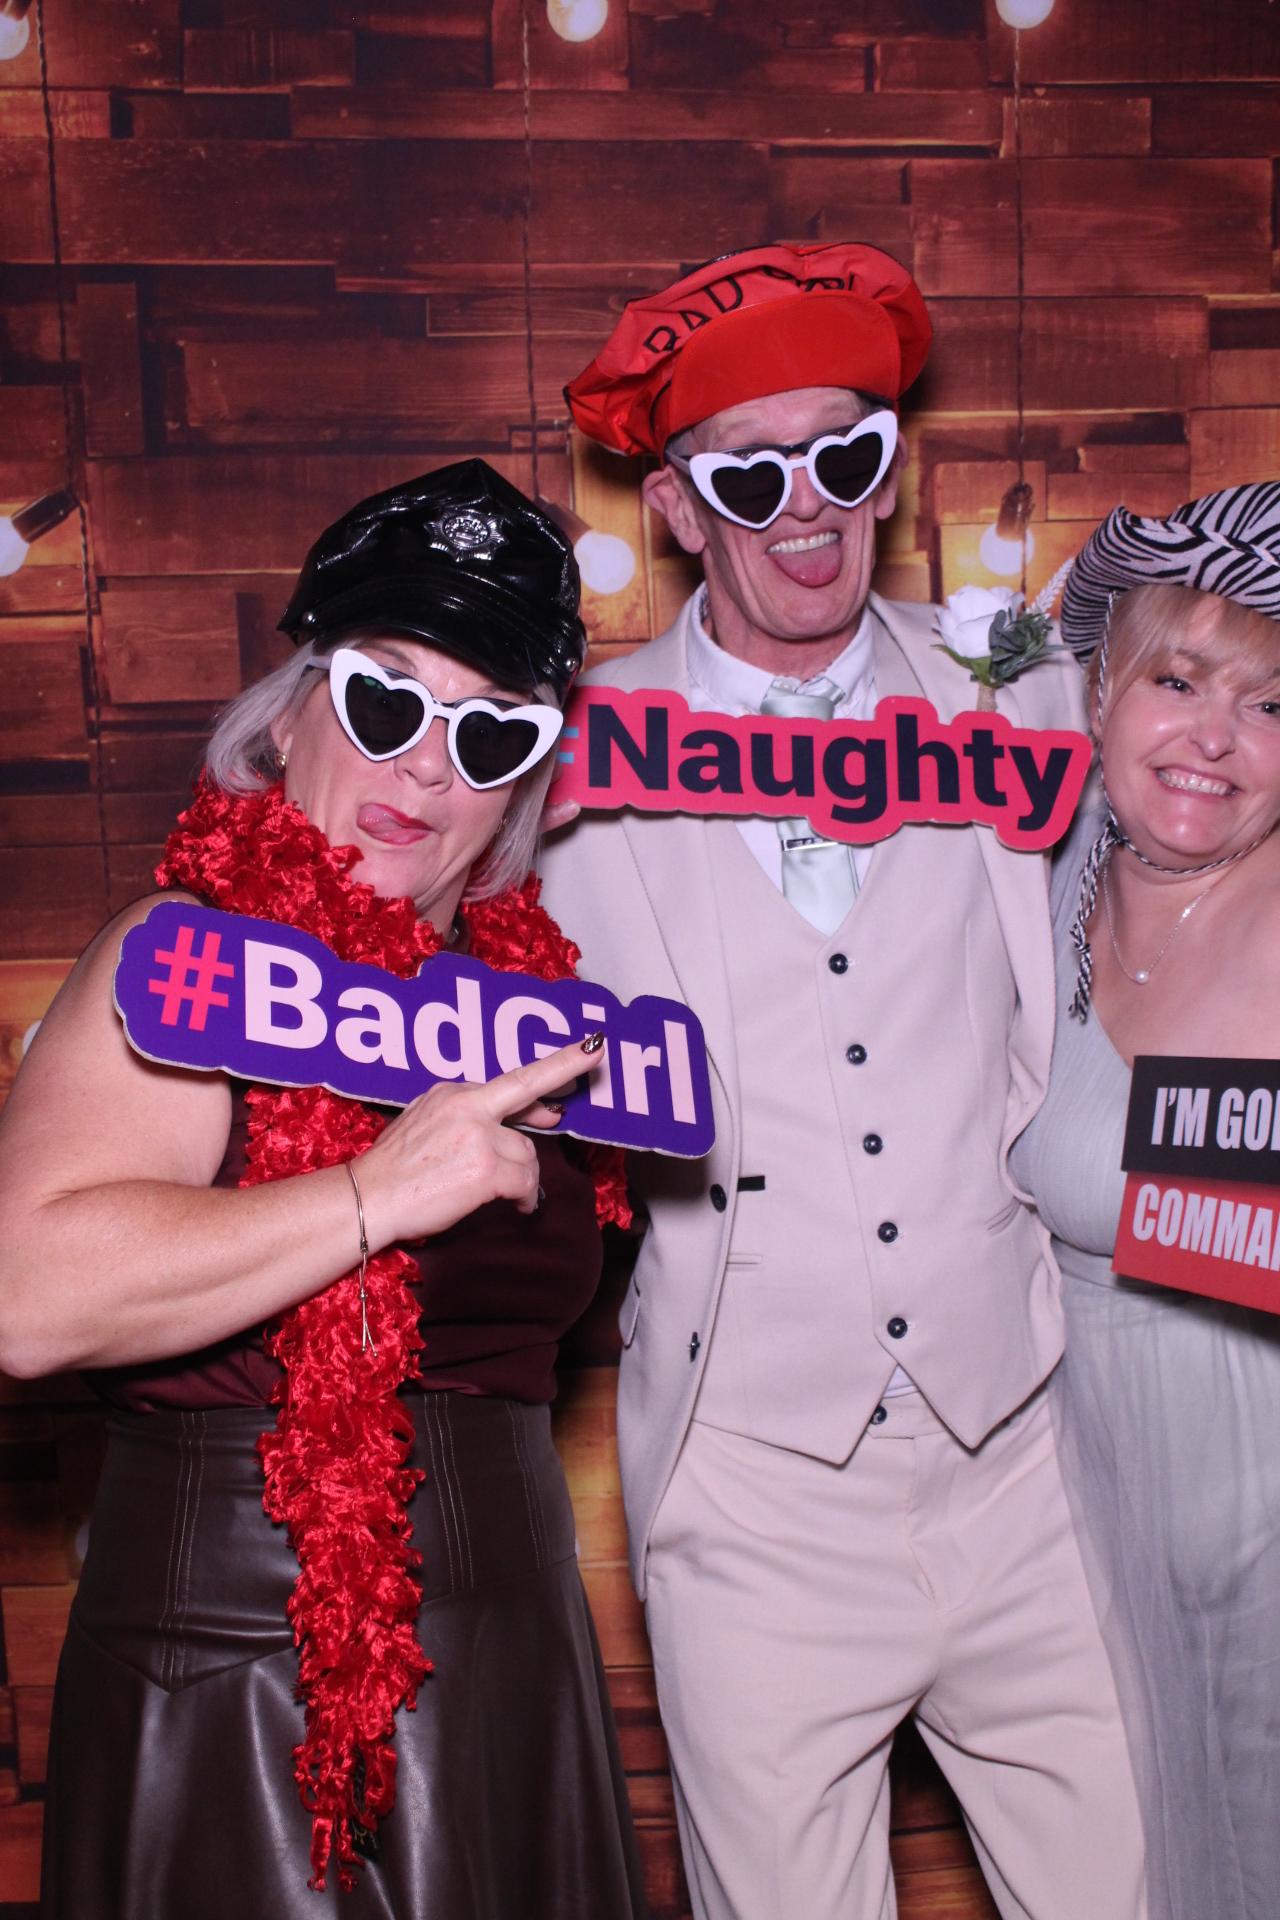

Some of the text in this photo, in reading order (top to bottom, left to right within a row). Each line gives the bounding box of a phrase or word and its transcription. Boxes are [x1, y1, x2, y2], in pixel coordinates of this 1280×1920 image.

[557, 703, 1074, 832] Naughty
[148, 926, 697, 1125] #BadGirl
[1151, 1086, 1211, 1148] I'M
